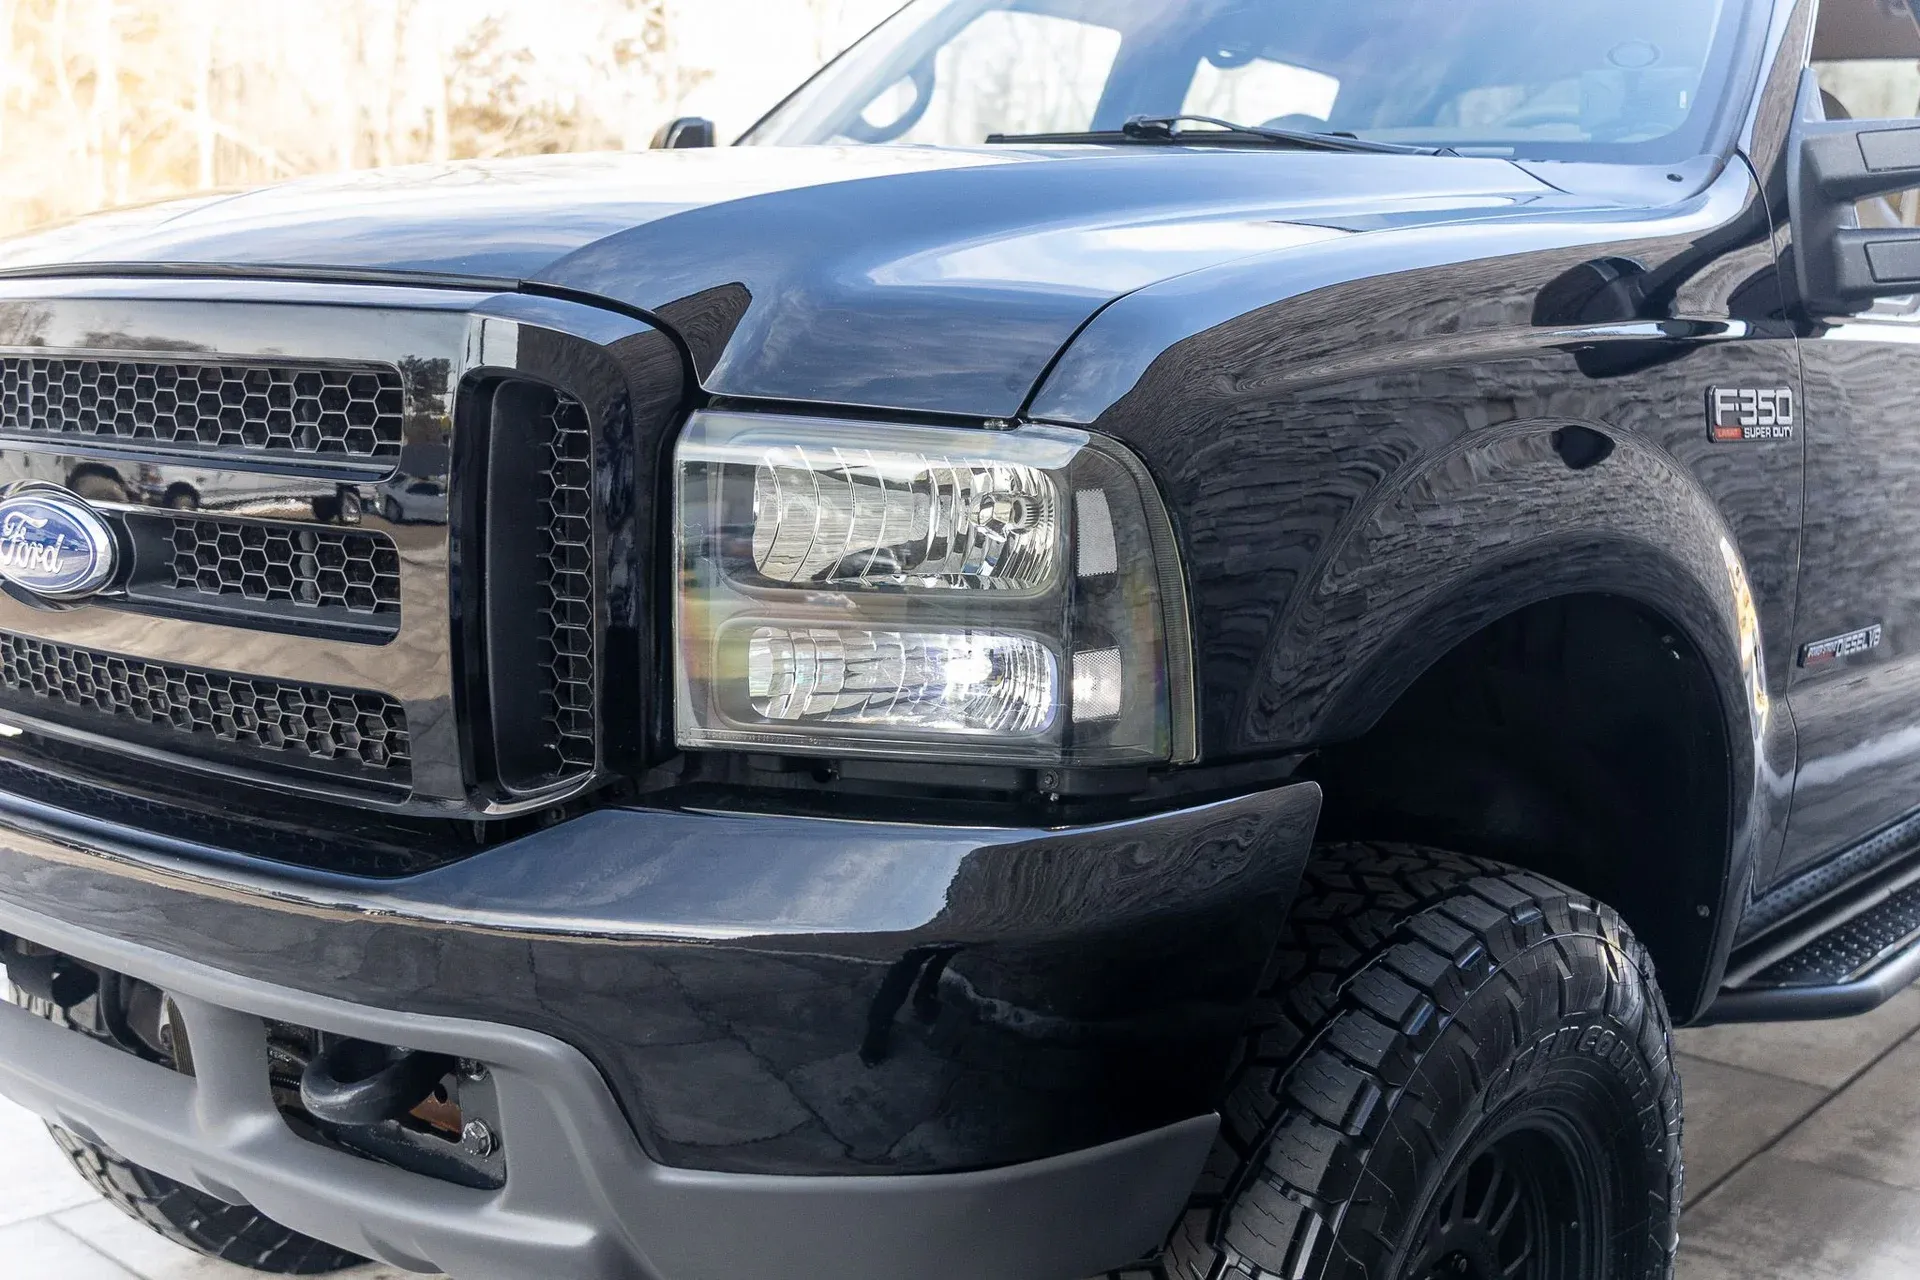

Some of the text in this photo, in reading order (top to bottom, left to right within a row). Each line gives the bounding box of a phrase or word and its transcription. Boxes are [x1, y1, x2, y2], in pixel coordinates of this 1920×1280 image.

[1744, 426, 1793, 438] SUPER DUTY
[0, 511, 65, 574] Ford
